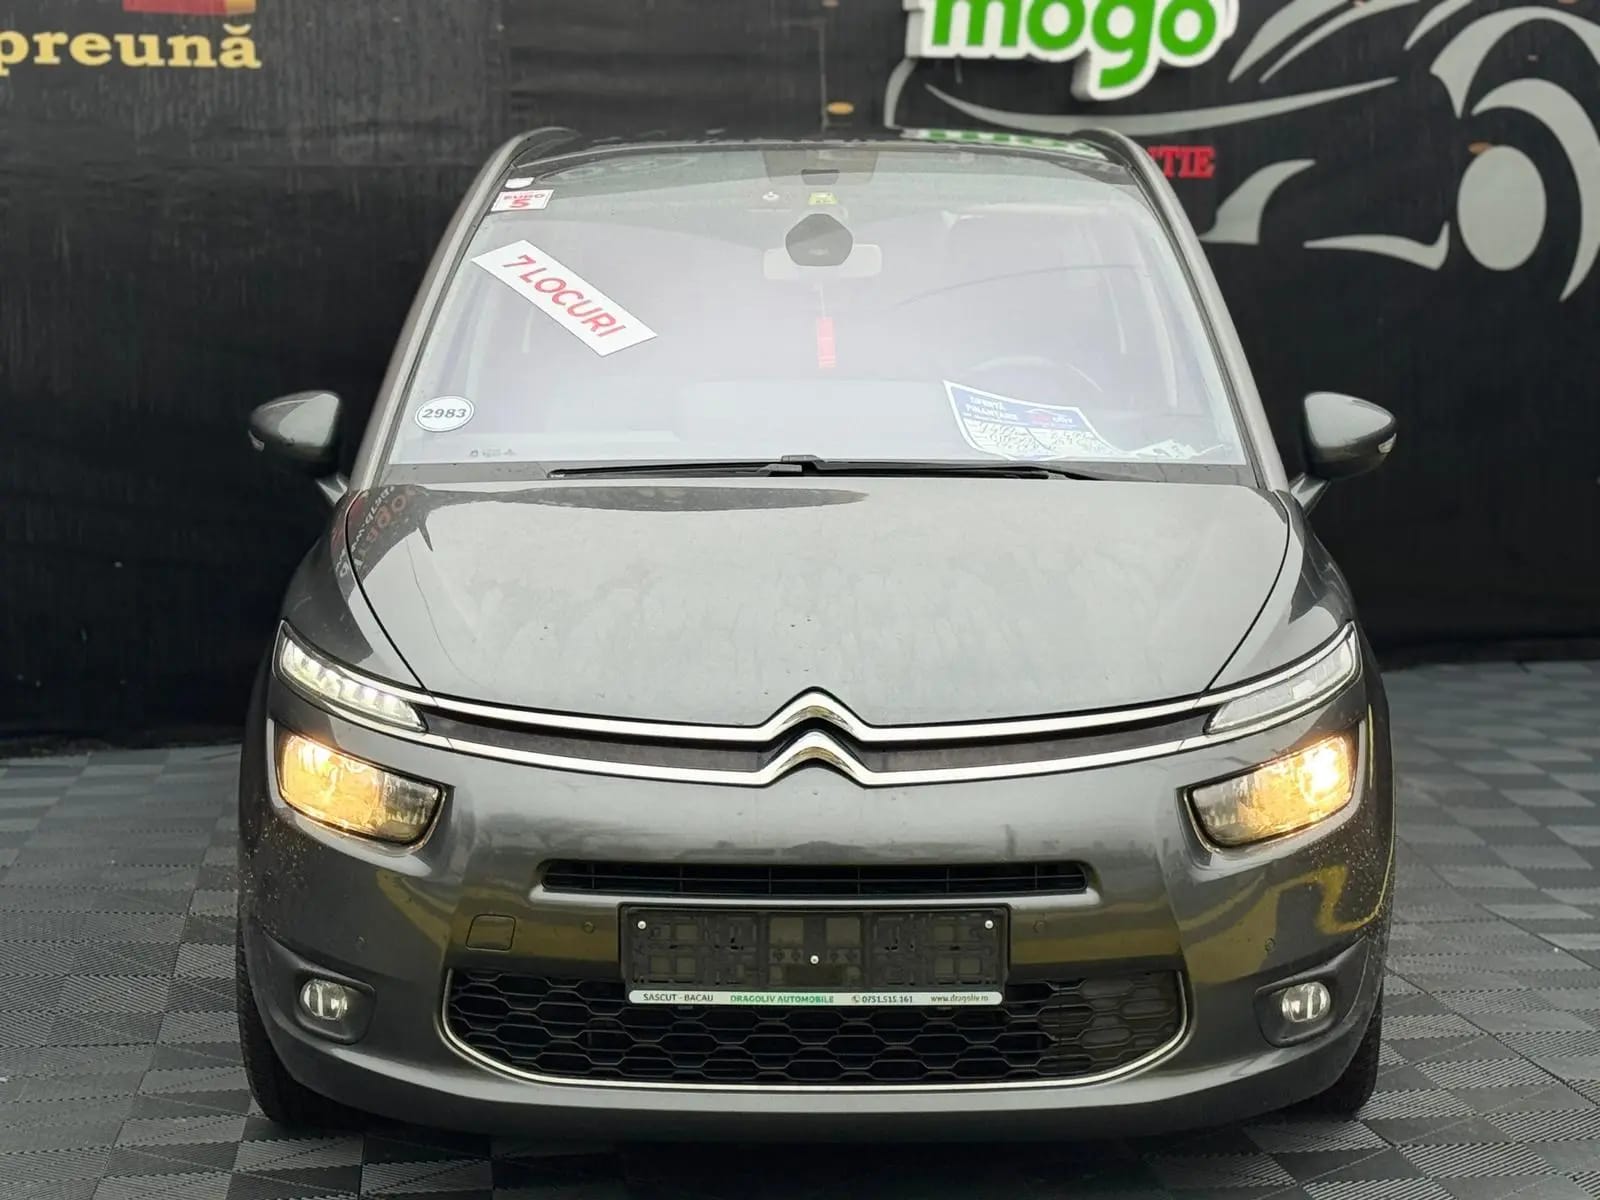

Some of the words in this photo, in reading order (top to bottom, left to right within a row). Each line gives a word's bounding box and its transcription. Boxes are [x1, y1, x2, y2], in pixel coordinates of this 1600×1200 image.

[0, 23, 262, 76] preună
[930, 0, 1217, 89] mogo
[502, 254, 537, 268] 7
[519, 266, 627, 337] LOCURI
[421, 407, 468, 419] 2983
[643, 993, 677, 1002] SASCUT
[730, 995, 776, 1003] DRAGOLIV
[777, 995, 834, 1004] AUTOMOBILE
